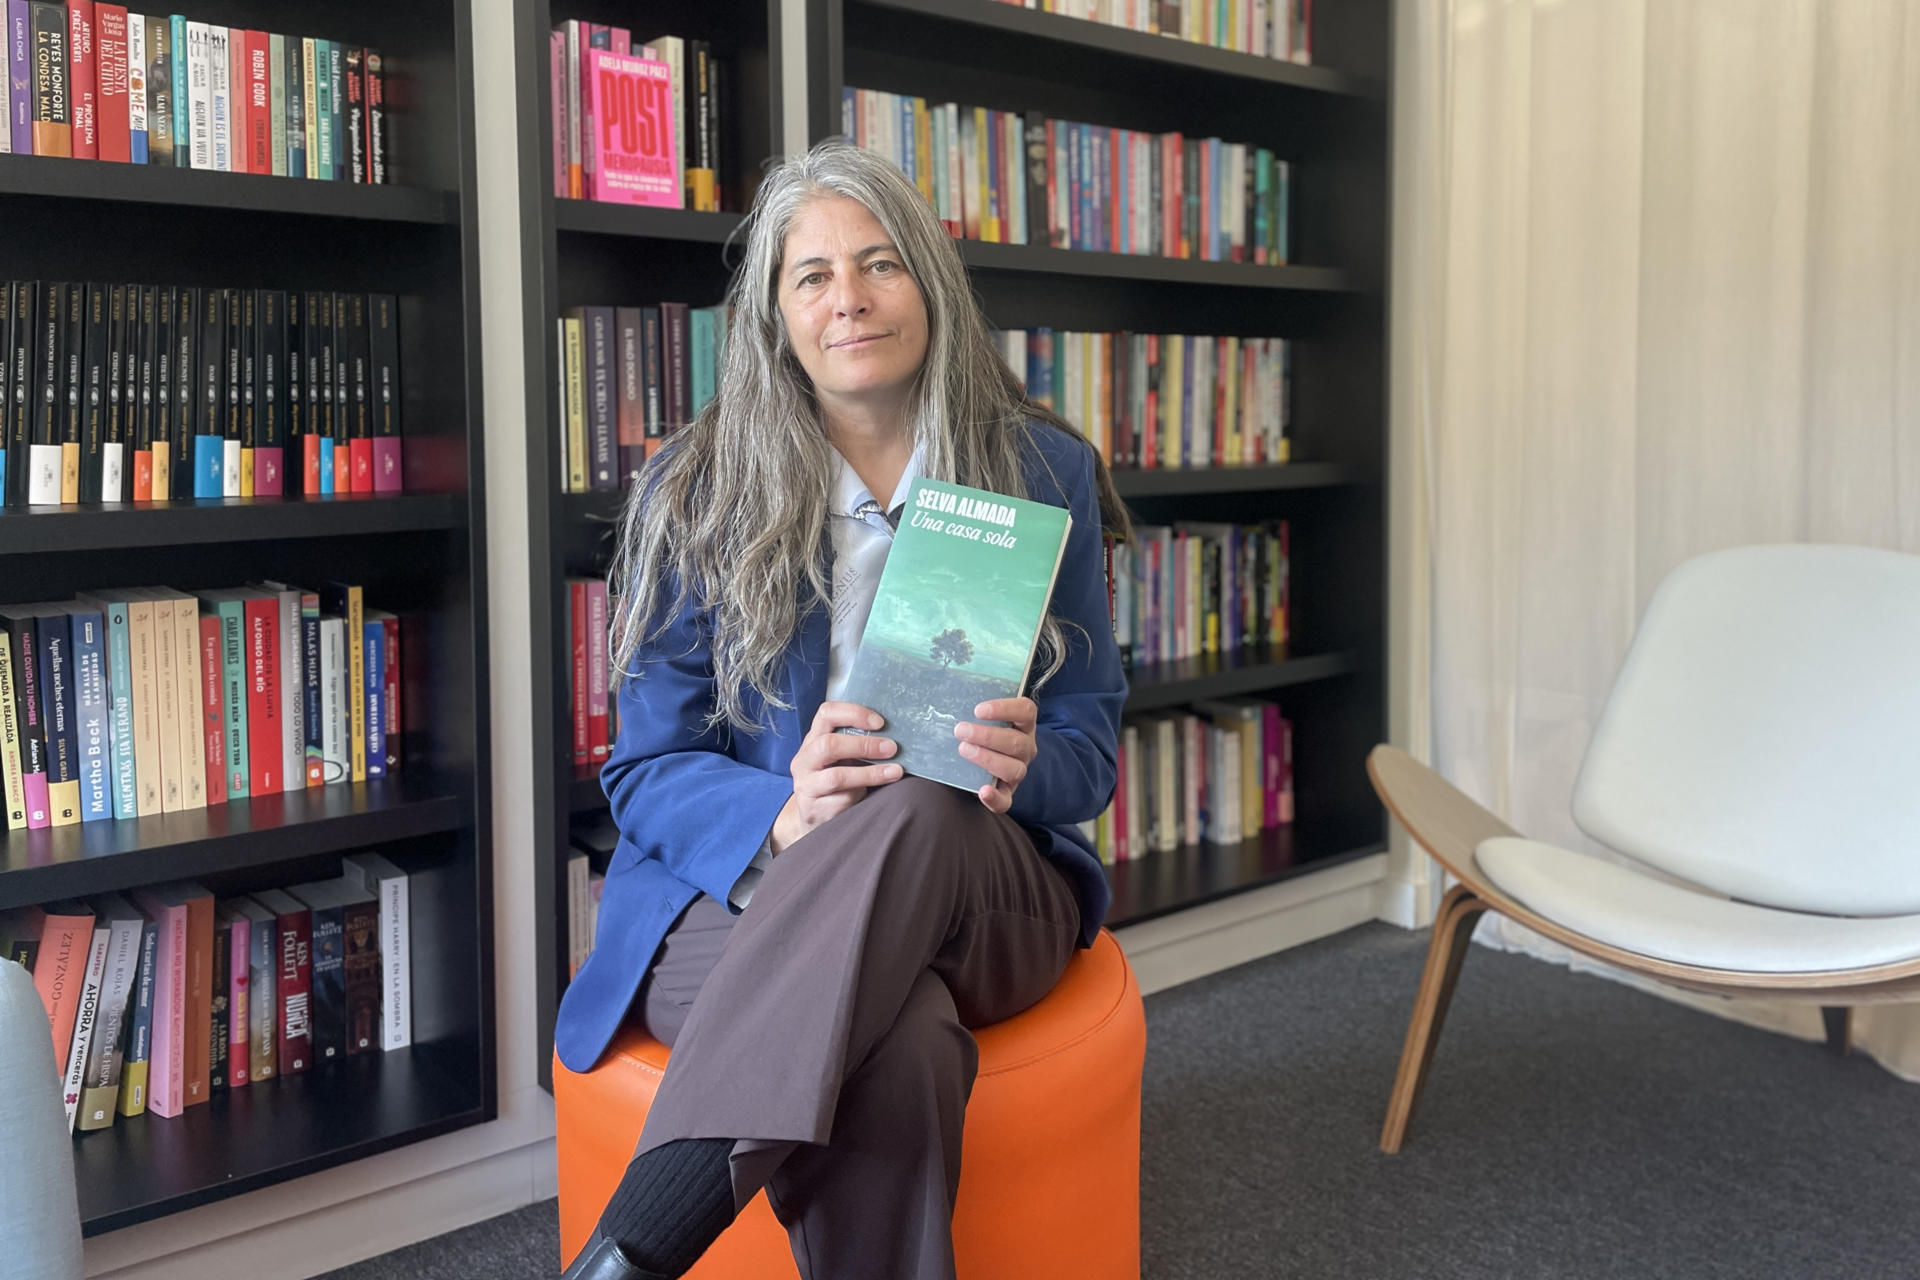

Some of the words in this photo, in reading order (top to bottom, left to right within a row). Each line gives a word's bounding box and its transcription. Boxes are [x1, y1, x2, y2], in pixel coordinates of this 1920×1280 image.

[16, 18, 24, 40] LAURA
[103, 13, 123, 22] Mario
[103, 21, 125, 30] Vargas
[38, 31, 49, 44] LA
[51, 33, 62, 62] REYES
[73, 10, 82, 63] PÉREZ-REVERTE
[82, 22, 91, 54] ARTURO
[101, 40, 113, 60] DEL
[114, 41, 126, 55] LA
[17, 41, 25, 62] CHICA
[253, 50, 265, 80] ROBIN
[332, 50, 340, 74] David
[39, 48, 50, 92] CONDESA
[101, 61, 114, 96] CHIVO
[115, 57, 127, 94] FIESTA
[52, 66, 64, 120] MONFORTE
[84, 93, 92, 101] EL
[254, 82, 266, 108] COOK
[333, 75, 341, 115] Foenkinos
[75, 107, 84, 129] FINAL
[85, 104, 93, 145] PROBLEMA
[195, 101, 207, 127] ALGUIEN
[600, 70, 669, 158] POST
[916, 488, 957, 515] SELVA
[957, 497, 1017, 528] ALMADA
[911, 510, 945, 533] Una
[945, 521, 982, 542] casa
[982, 529, 1017, 549] sola
[593, 597, 602, 619] PARA
[22, 633, 32, 656] NADIE
[226, 617, 239, 665] CHARLATANES
[255, 617, 263, 658] ALFONSO
[265, 629, 273, 661] CIUDAD
[307, 622, 317, 656] MALAS
[593, 621, 602, 656] SIEMPRE
[49, 637, 61, 672] Aquellas
[83, 655, 89, 665] DE
[256, 659, 264, 675] DEL
[24, 656, 33, 684] OLVIDA
[81, 667, 90, 688] ALLÁ
[92, 652, 100, 692] ANSIEDAD
[309, 658, 318, 688] HIJAS
[594, 658, 603, 695] CONTIGO
[26, 684, 34, 695] TU
[53, 673, 63, 701] noches
[209, 681, 217, 705] comida
[231, 681, 240, 706] MOISÉS
[256, 677, 266, 693] RÍO
[27, 696, 37, 726] NOMBRE
[93, 694, 100, 705] LA
[294, 692, 302, 715] TODO
[4, 704, 14, 745] REALIZADA
[55, 702, 65, 732] eternas
[118, 697, 129, 737] VERANO
[295, 716, 302, 727] LO
[59, 738, 67, 761] SILVIA
[87, 719, 100, 756] Beck
[120, 738, 131, 756] SEA
[9, 750, 18, 776] ANDREA
[31, 739, 40, 765] Adriana
[11, 777, 20, 804] FRANCO
[89, 761, 104, 813] Martha
[121, 759, 133, 813] MIENTRAS
[392, 885, 400, 925] PRÍNCIPE
[117, 931, 131, 964] DANIEL
[145, 932, 155, 951] Solo
[297, 941, 308, 966] KEN
[52, 933, 74, 1001] GONZÁLEZ
[93, 943, 104, 976] SARAFERO
[144, 951, 152, 977] cartas
[283, 931, 298, 981] FOLLETT
[393, 963, 400, 975] EN
[113, 968, 124, 996] ROJAS
[142, 977, 151, 987] de
[393, 977, 400, 988] LA
[80, 984, 98, 1033] AHORRA
[141, 987, 149, 1007] amor
[393, 990, 401, 1028] SOMBRA
[106, 1004, 119, 1045] VIENTOS
[219, 1024, 227, 1036] LA
[286, 993, 309, 1040] NUNCA
[104, 1046, 114, 1058] DE
[218, 1037, 227, 1062] ROSA
[72, 1044, 85, 1085] vencerás
